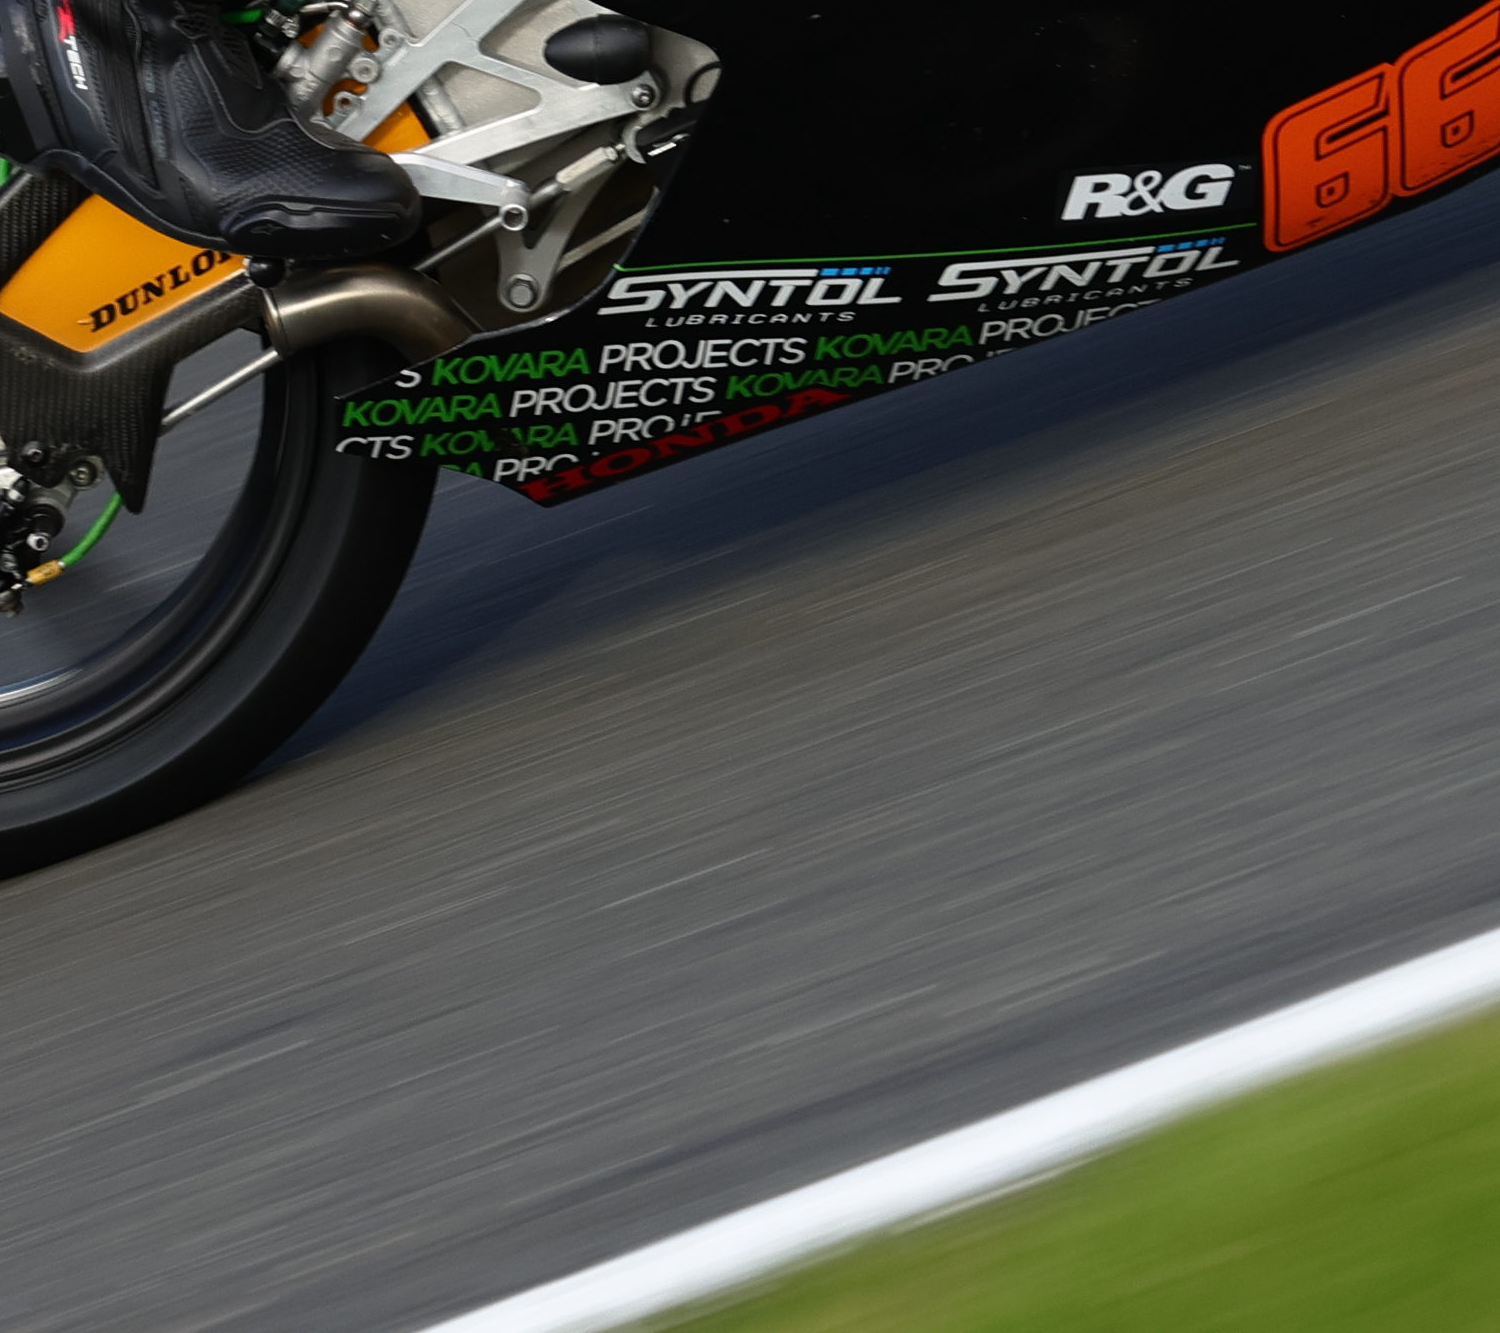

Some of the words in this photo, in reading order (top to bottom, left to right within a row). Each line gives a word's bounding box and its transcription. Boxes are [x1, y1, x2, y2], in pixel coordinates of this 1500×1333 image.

[1061, 163, 1235, 221] R&G
[645, 310, 856, 329] LUBRICANTS
[976, 276, 1195, 313] LUBRICANTS
[430, 347, 591, 387] KOVARA
[598, 337, 808, 375] PROJECTS
[813, 324, 974, 361] KOVARA
[341, 392, 503, 428] KOVARA
[508, 376, 718, 418] PROJECTS
[725, 364, 885, 400] KOVARA
[518, 387, 852, 502] HONDA
